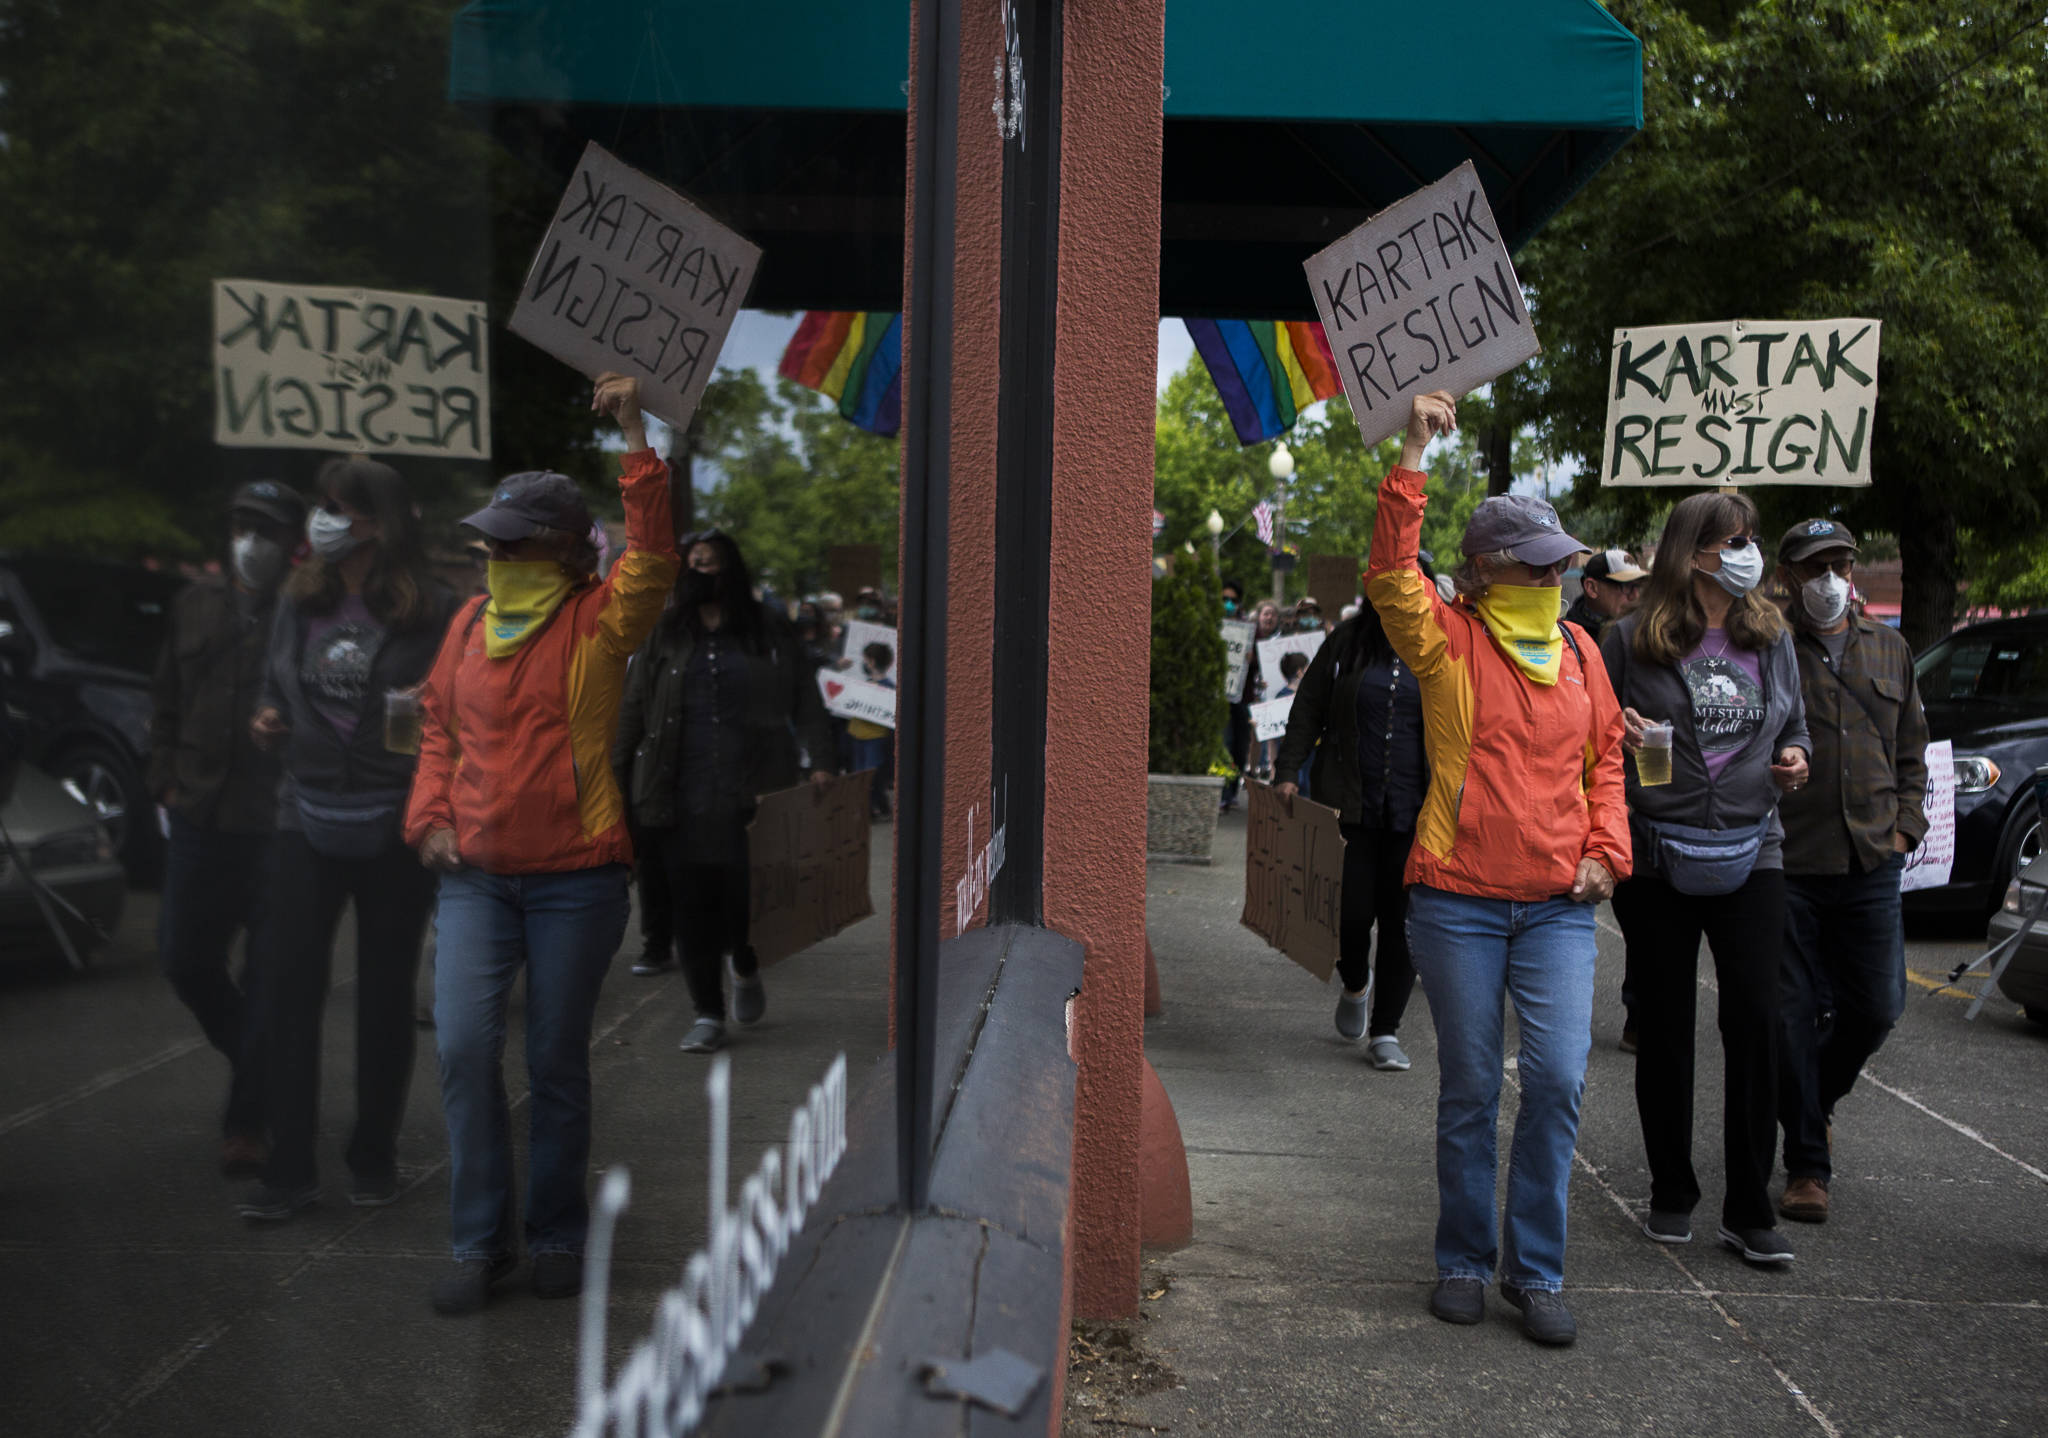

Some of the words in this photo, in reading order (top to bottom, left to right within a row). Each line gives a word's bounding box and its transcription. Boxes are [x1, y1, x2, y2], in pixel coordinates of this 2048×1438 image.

[1323, 190, 1495, 331] KARTAK
[1347, 260, 1522, 411] RESIGN
[1613, 325, 1874, 403] KARTAK
[1700, 388, 1774, 416] MUST
[1609, 406, 1869, 480] RESIGN
[1695, 706, 1765, 720] MESTEAD
